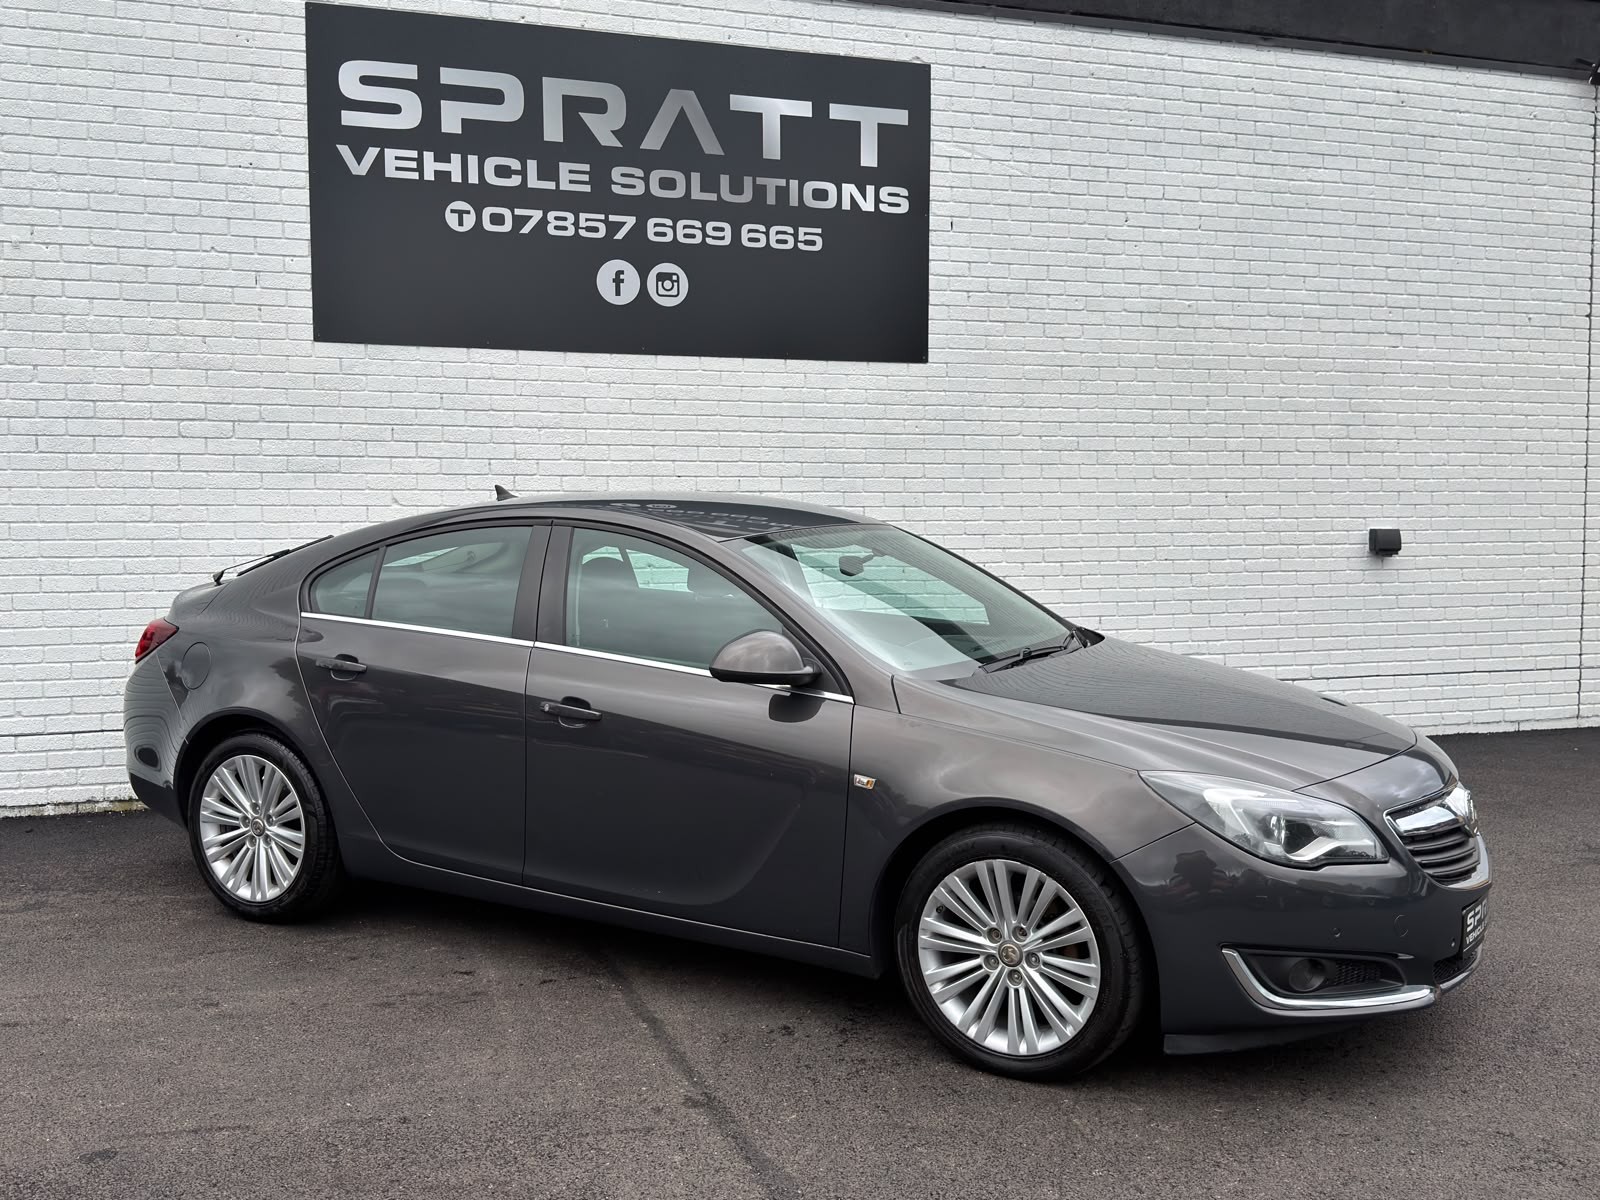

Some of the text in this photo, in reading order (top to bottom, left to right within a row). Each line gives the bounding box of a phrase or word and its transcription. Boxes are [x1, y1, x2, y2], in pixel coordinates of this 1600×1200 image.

[338, 60, 908, 167] SPRATT
[336, 144, 910, 214] VEHICLE SOLUTIONS
[482, 207, 636, 240] 07857
[647, 218, 732, 246] 669
[741, 224, 823, 251] 665
